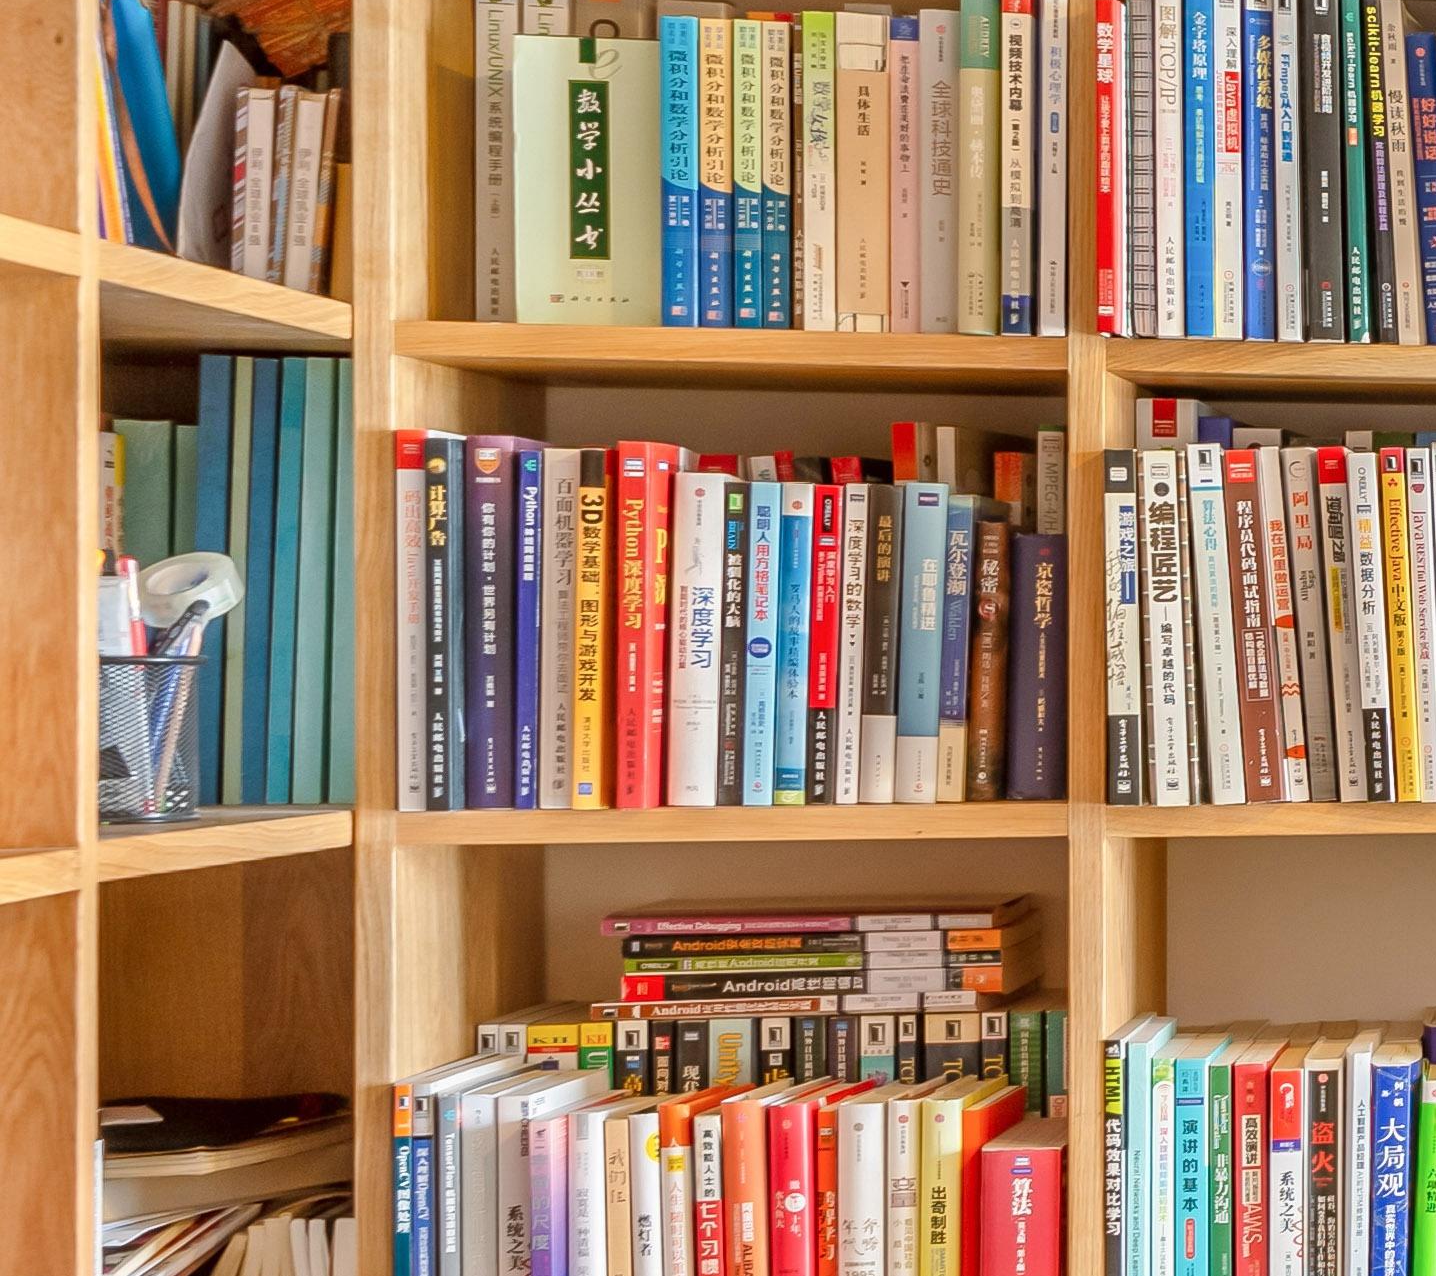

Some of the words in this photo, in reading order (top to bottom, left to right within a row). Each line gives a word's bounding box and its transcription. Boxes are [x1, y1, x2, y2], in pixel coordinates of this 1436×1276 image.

[1007, 33, 1023, 112] 视频技术内幕
[1159, 5, 1179, 106] 图解TCP/IP
[1191, 11, 1209, 80] 金字塔原理
[1224, 26, 1238, 70] 深入理解
[1256, 35, 1273, 110] 多媒体系统
[1365, 6, 1380, 86] scikit-learn
[669, 49, 689, 183] 微积分和数学分析引论
[705, 51, 726, 184] 微积分和数学分析引论
[741, 51, 757, 184] 微积分和数学分析引论
[769, 55, 785, 186] 微积分和数学分析引论
[857, 85, 871, 137] 具体生活
[930, 79, 953, 196] 全球科技通史
[1225, 73, 1239, 153] Java虚拟机
[576, 88, 603, 253] 数学小丛书
[429, 484, 447, 549] 计算广告
[1149, 501, 1179, 603] 编程匠艺
[621, 498, 643, 629] Python深度学习
[946, 528, 968, 597] 瓦尔登湖
[1034, 561, 1055, 629] 京瓷哲学
[1236, 500, 1260, 629] 程序员代码面试指南
[689, 585, 714, 670] 深度学习
[1011, 1178, 1033, 1216] 算法
[1182, 1118, 1199, 1213] 演讲的基本
[1214, 1153, 1229, 1225] 非暴力沟通
[1376, 1116, 1405, 1198] 大局观
[701, 1203, 721, 1276] 七个习惯
[929, 1186, 947, 1246] 出奇制胜
